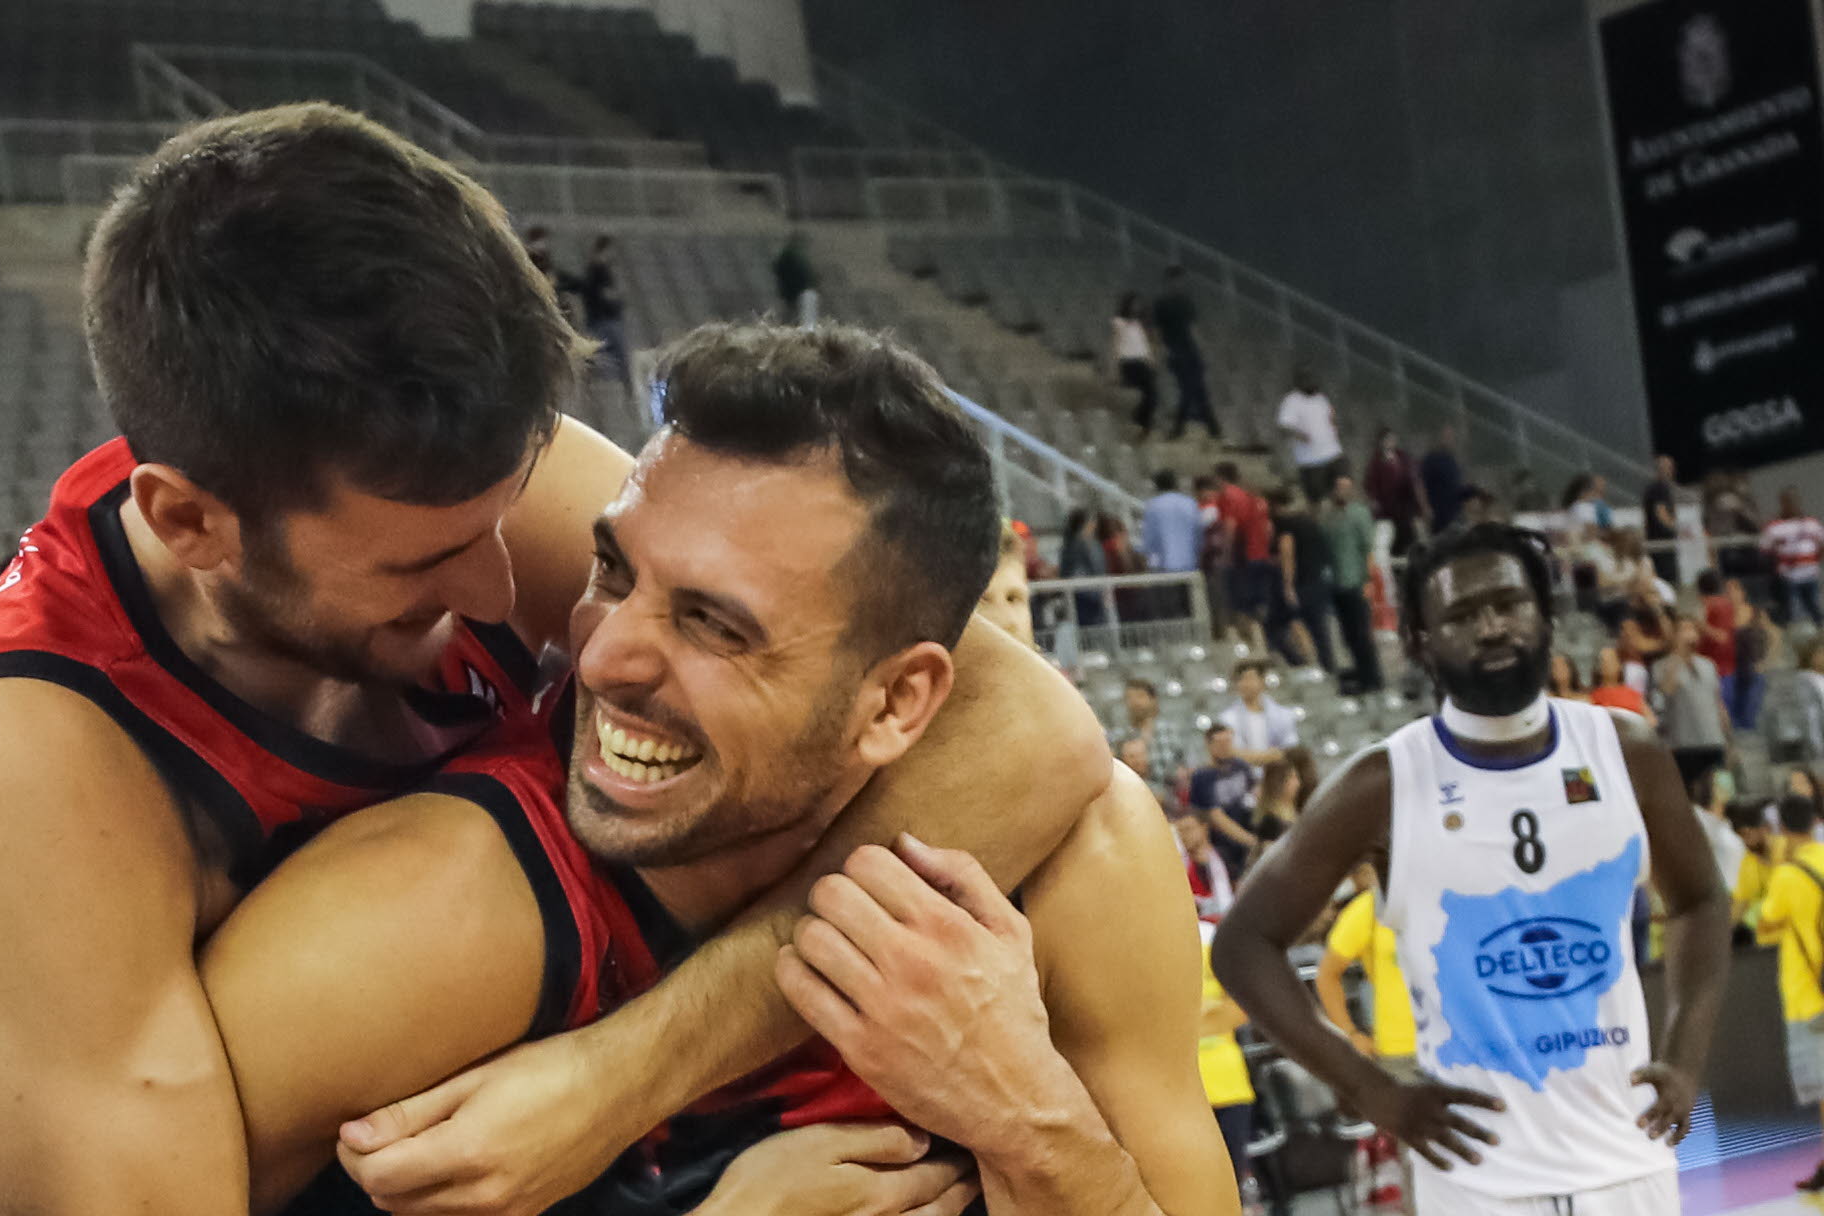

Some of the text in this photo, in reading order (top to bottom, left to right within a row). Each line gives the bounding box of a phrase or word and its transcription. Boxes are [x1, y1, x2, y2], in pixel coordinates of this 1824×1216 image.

[1511, 808, 1546, 874] 8
[1475, 940, 1611, 978] DELTECO
[1536, 1027, 1630, 1054] GIPUZKO
